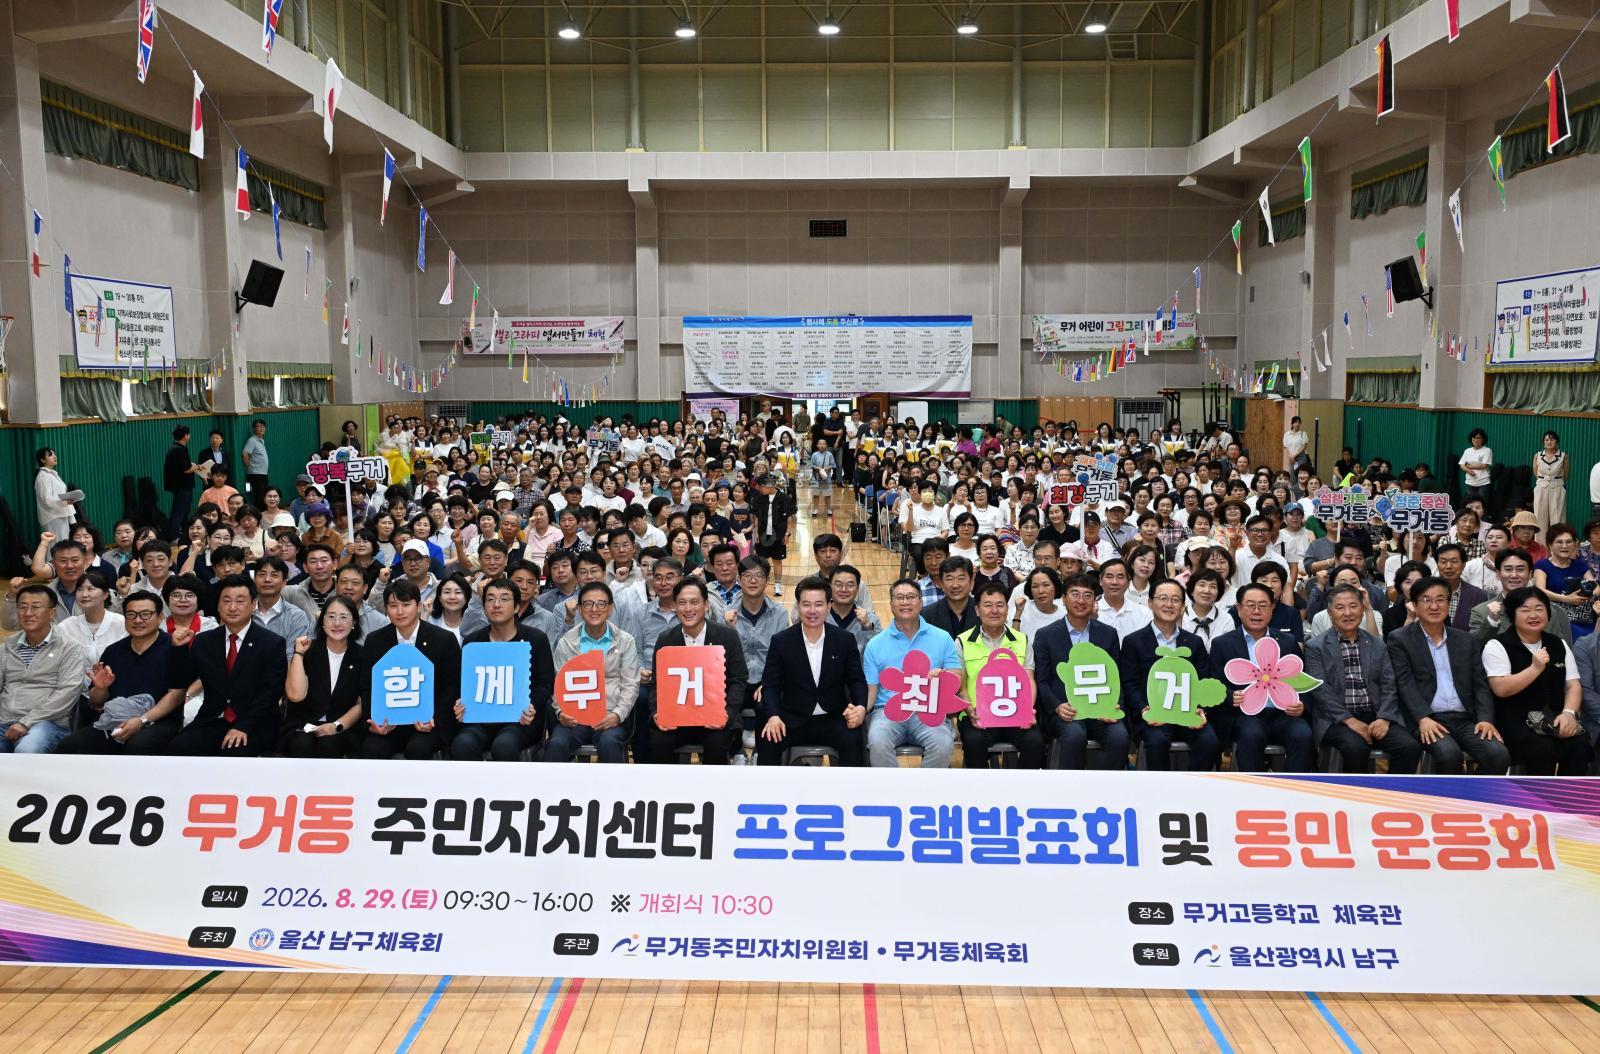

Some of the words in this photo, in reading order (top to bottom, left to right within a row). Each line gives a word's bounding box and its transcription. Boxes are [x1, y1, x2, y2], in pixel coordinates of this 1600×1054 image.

[542, 328, 585, 342] 엽서만들기
[587, 329, 606, 341] 체험
[1060, 321, 1076, 333] 무거
[1079, 320, 1103, 332] 어린이
[1318, 505, 1368, 522] 무거동
[1391, 510, 1449, 532] 무거동
[384, 667, 424, 708] 함
[476, 666, 514, 705] 께
[563, 669, 601, 710] 무
[668, 667, 704, 706] 거
[901, 674, 939, 714] 최
[982, 676, 1022, 717] 강
[1073, 664, 1111, 704] 무
[1155, 671, 1190, 712] 거
[7, 793, 165, 847] 2026
[182, 794, 354, 854] 무거동
[371, 797, 715, 860] 주민자치센터
[734, 804, 1140, 867] 프로그램발표회
[1159, 811, 1213, 867] 및
[1235, 810, 1355, 868] 동민
[1371, 812, 1556, 871] 운동회
[211, 890, 238, 903] 일시
[262, 887, 327, 908] 2026.
[335, 887, 356, 909] 8.
[639, 893, 703, 915] 개회식
[712, 894, 774, 916] 10:30
[1139, 907, 1166, 919] 장소
[1184, 902, 1320, 925] 무거고등학교
[1333, 904, 1403, 926] 체육관
[200, 931, 228, 943] 주최
[279, 929, 325, 951] 울산
[329, 931, 444, 952] 남구체육회
[563, 938, 591, 950] 주관
[645, 936, 869, 961] 무거동주민자치위원회
[894, 940, 1029, 964] 무거동체육회
[1142, 947, 1170, 960] 후원
[1230, 945, 1346, 969] 울산광역시
[1352, 947, 1400, 970] 남구
